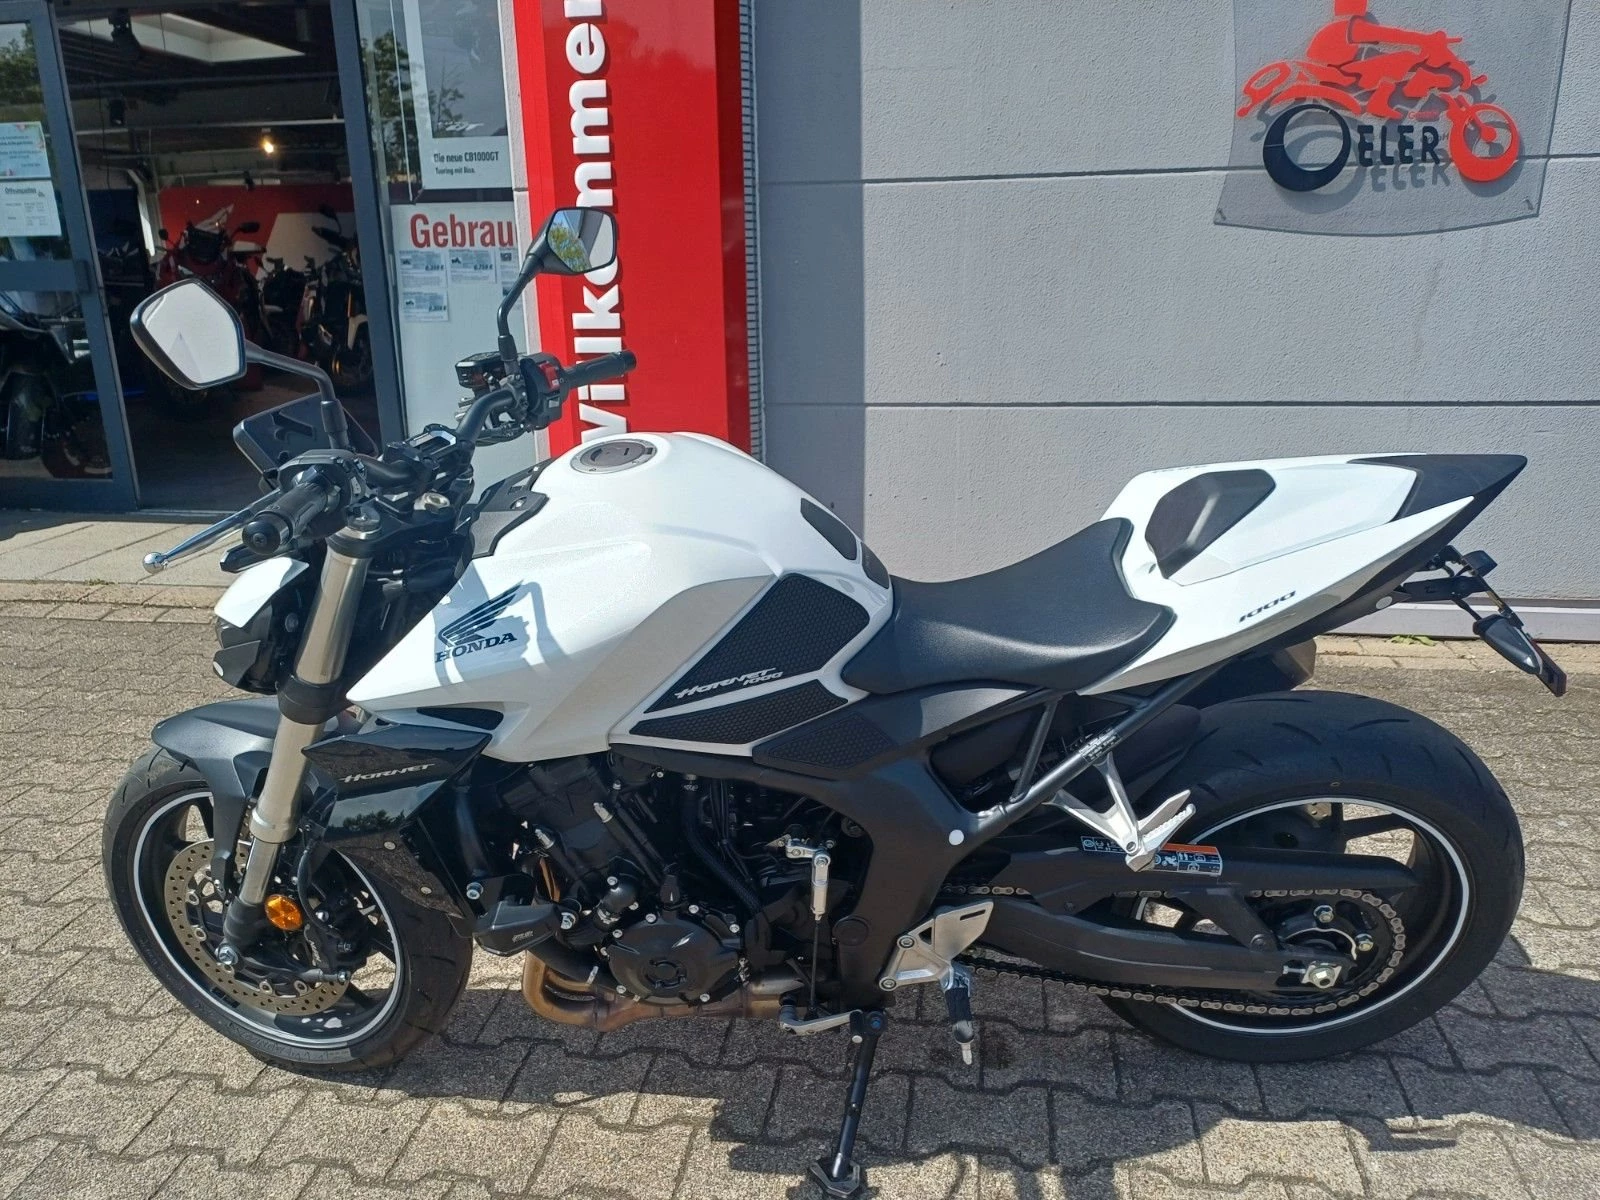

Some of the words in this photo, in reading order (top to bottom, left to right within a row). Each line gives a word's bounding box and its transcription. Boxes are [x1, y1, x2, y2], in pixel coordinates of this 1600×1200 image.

[446, 152, 463, 162] neue
[464, 151, 499, 162] CB1000GT
[410, 213, 516, 249] Gebrau
[1239, 591, 1296, 623] 1000
[435, 632, 518, 663] HONDA
